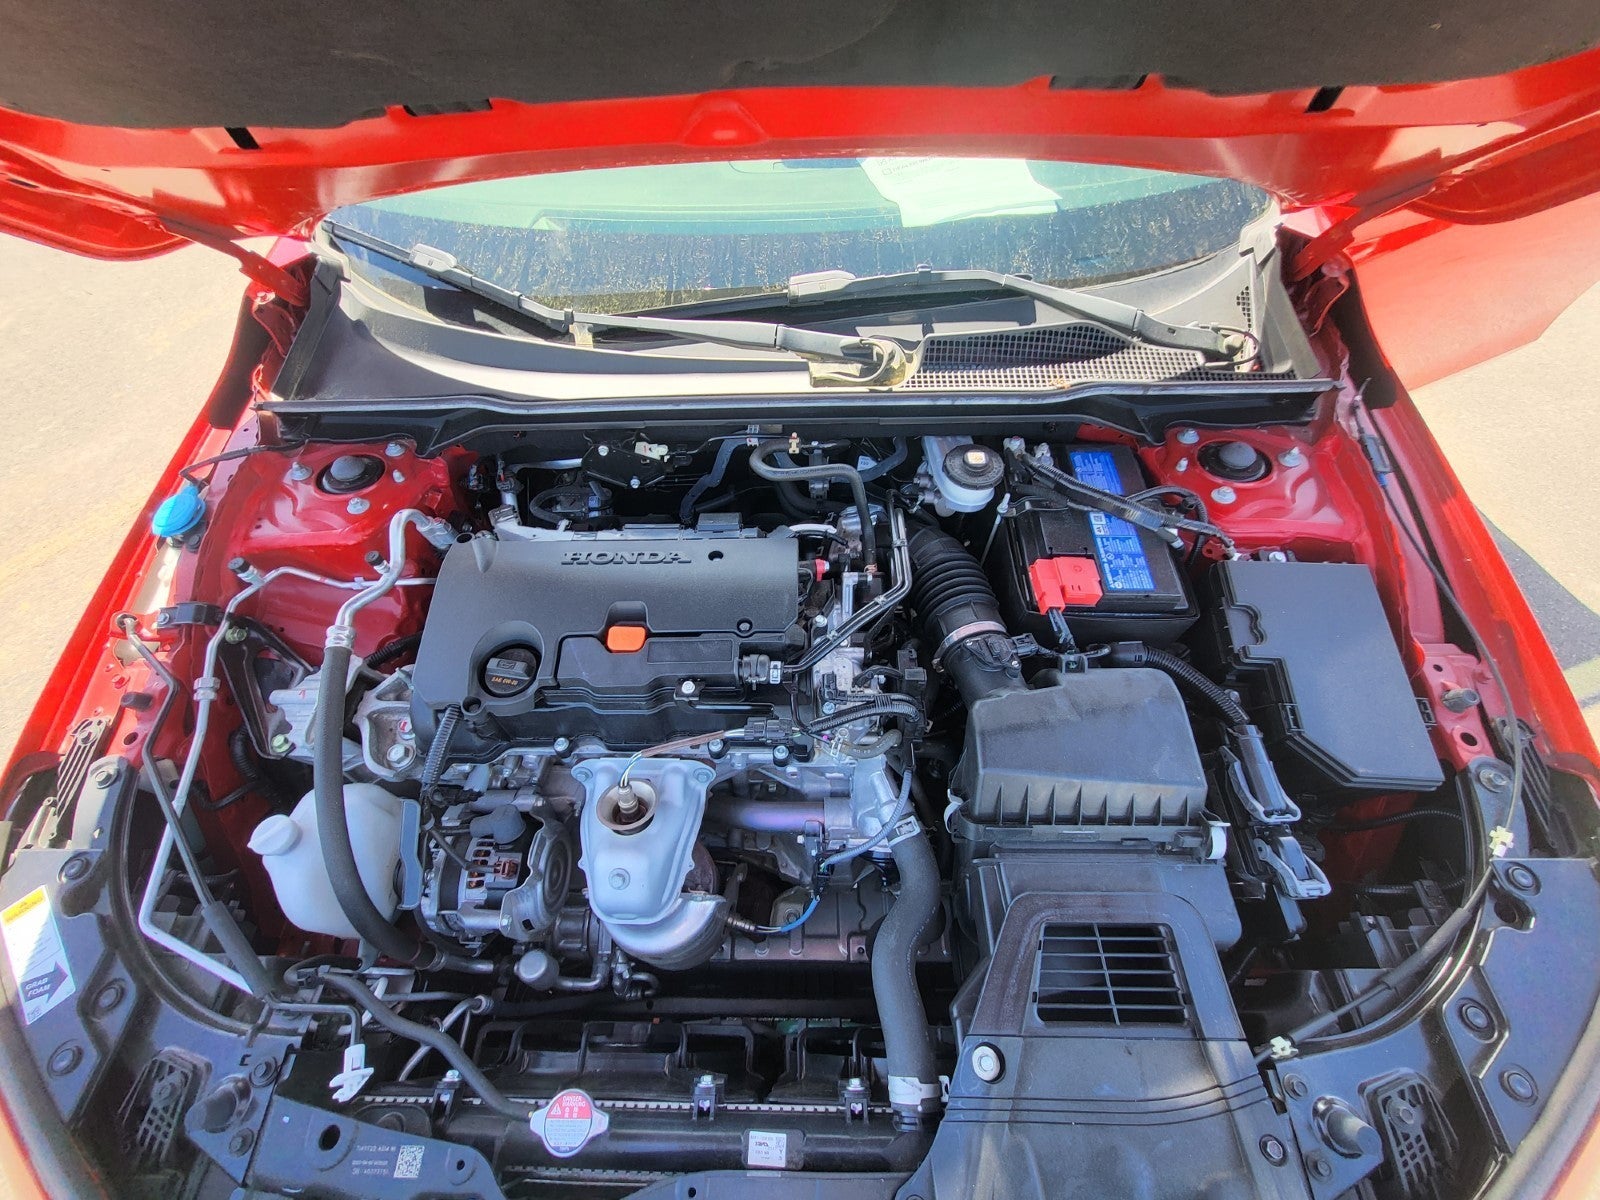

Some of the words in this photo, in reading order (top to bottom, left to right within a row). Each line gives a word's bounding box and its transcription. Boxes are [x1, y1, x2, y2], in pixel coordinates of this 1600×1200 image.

[561, 551, 692, 565] HONDA
[25, 977, 48, 990] GRAB
[27, 984, 51, 997] FOAM
